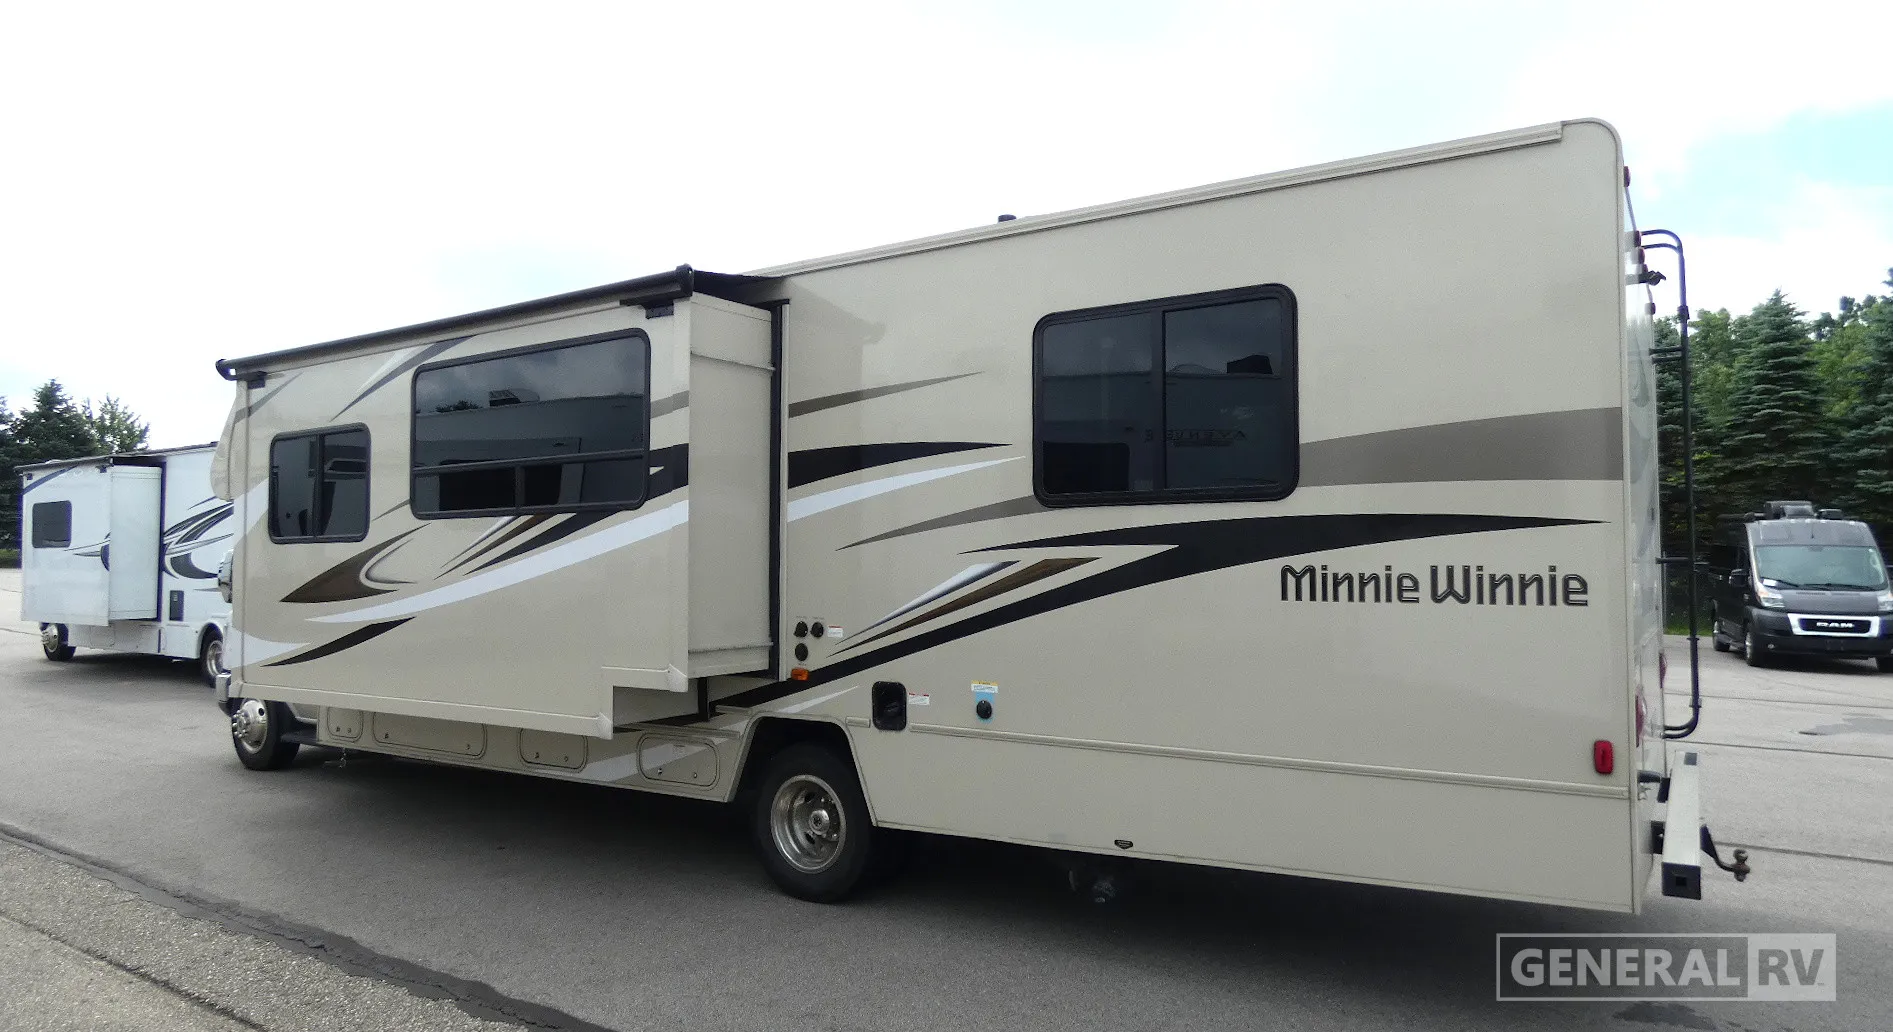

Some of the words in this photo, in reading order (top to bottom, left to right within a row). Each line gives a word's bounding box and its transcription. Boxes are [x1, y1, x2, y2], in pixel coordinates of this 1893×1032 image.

[1280, 564, 1420, 603] Minnie
[1430, 564, 1589, 607] Winnie
[1816, 621, 1855, 629] RAM
